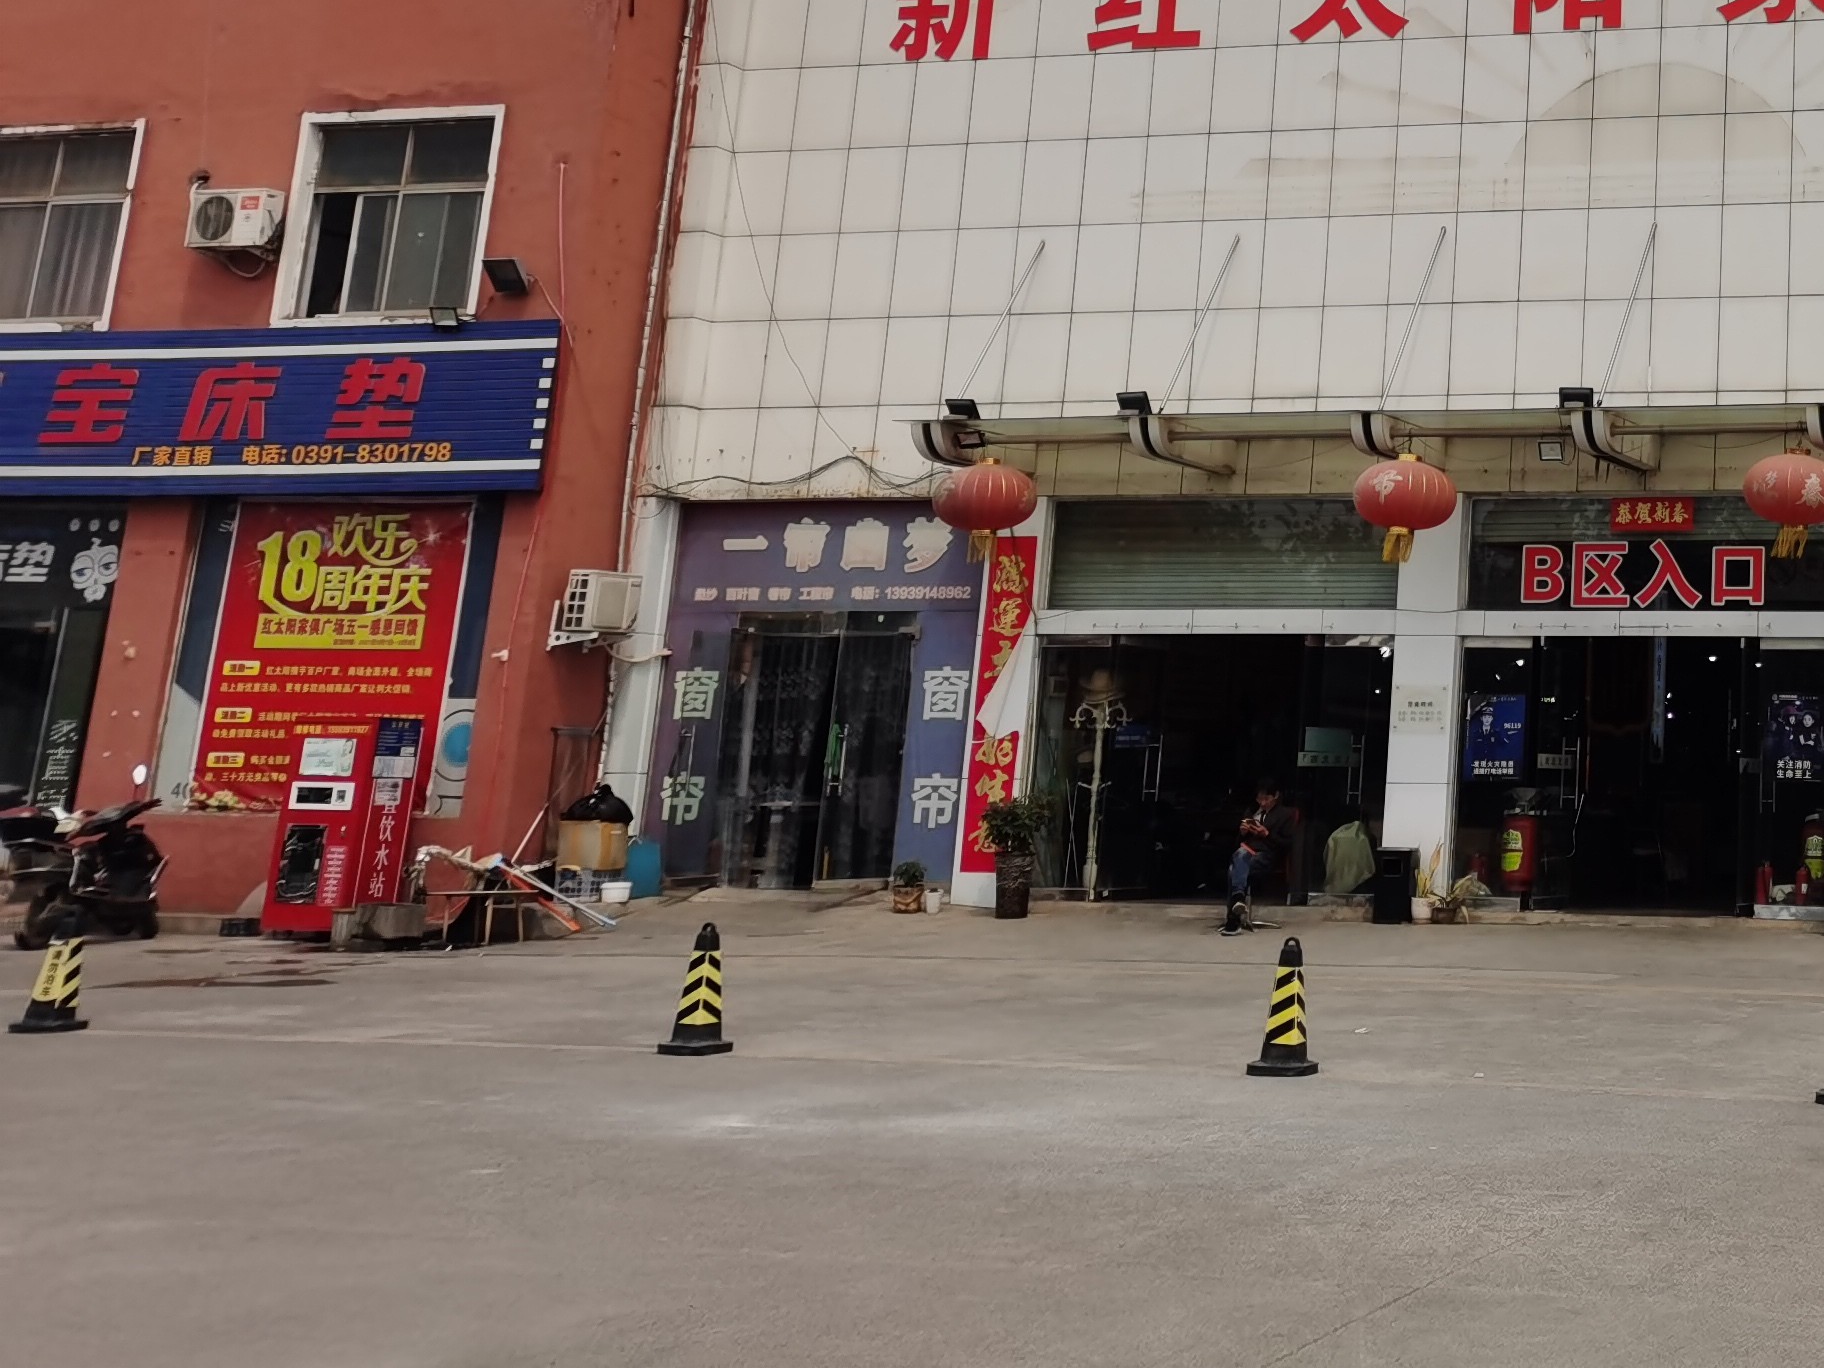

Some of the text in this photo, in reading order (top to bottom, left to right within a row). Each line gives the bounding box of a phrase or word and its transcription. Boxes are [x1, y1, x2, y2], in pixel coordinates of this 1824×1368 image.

[38, 357, 426, 443] 宝床垫
[131, 445, 214, 466] 厂家直销
[257, 530, 432, 612] 18 周年庆
[328, 513, 418, 566] 欢乐
[1520, 538, 1767, 609] B区入口
[660, 666, 720, 826] 窗帘
[911, 665, 971, 829] 窗帘
